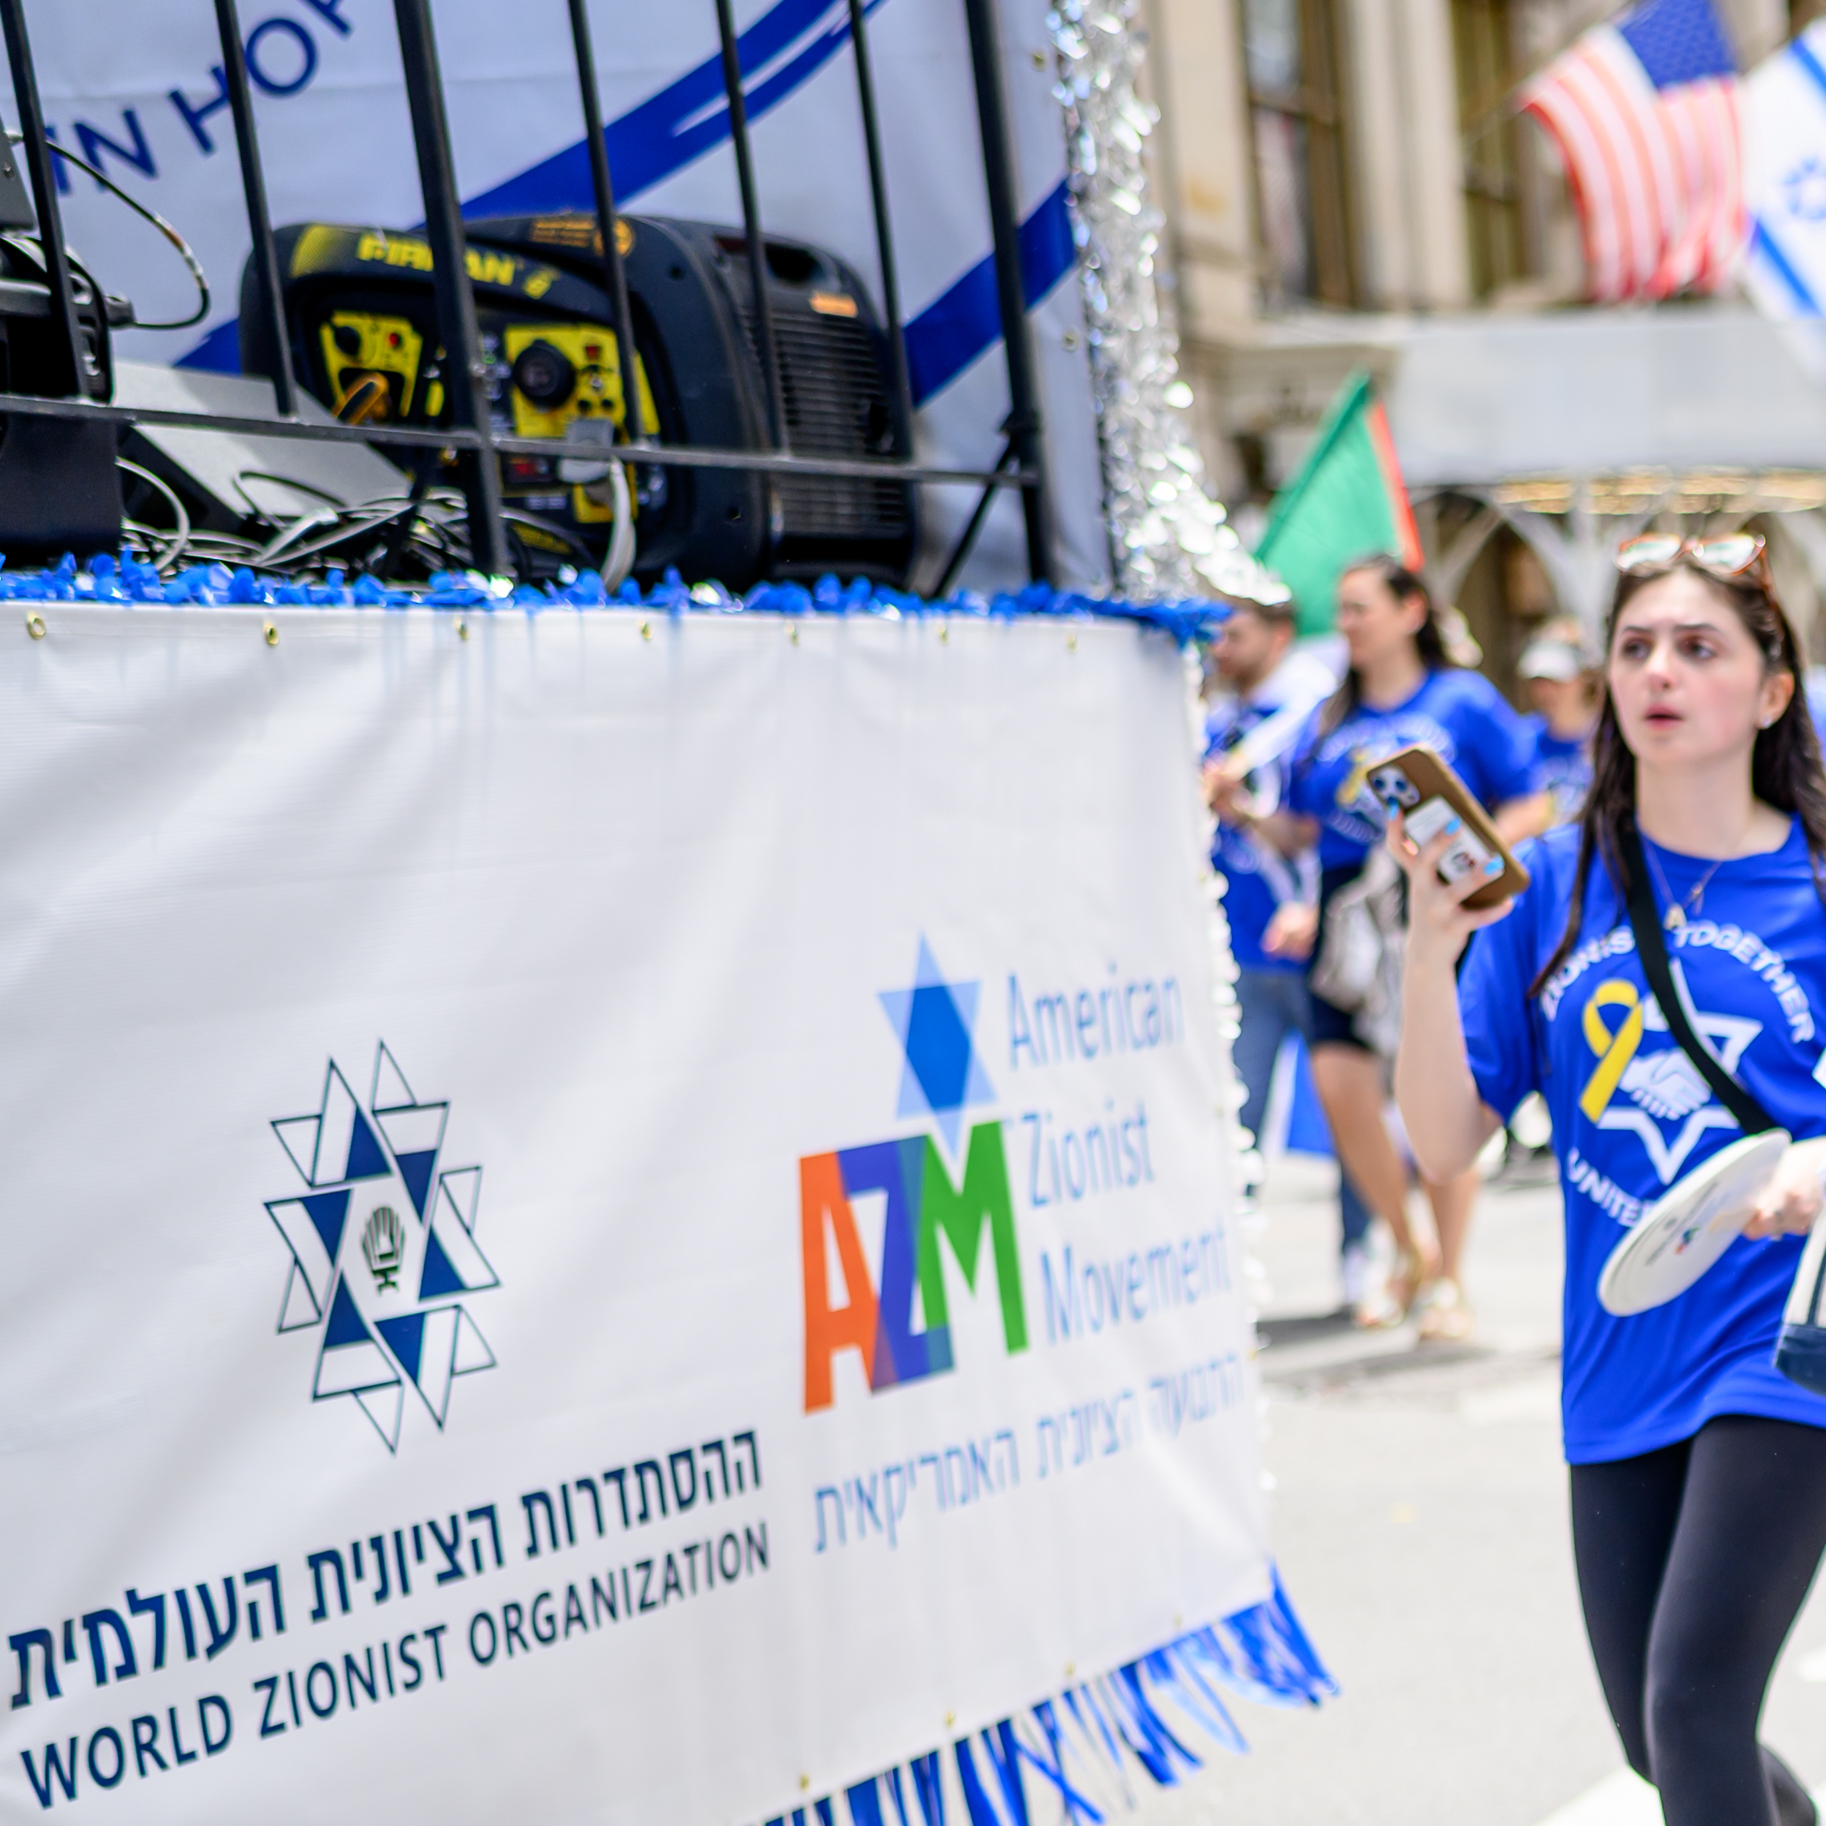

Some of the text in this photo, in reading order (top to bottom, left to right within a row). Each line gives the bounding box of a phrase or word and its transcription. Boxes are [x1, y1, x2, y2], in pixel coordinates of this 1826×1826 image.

[1006, 960, 1186, 1072] American
[1673, 919, 1816, 1043] TOGETHER
[1021, 1099, 1156, 1211] Zionist
[1566, 1147, 1655, 1228] UNITE
[798, 1120, 1030, 1417] AZM
[1040, 1212, 1234, 1347] Movement
[814, 1427, 1021, 1554] האמריקאית
[7, 1429, 764, 1710] ההסתדרות הציונית העולמית
[20, 1522, 770, 1810] WORLD ZIONIST ORGANIZATION
